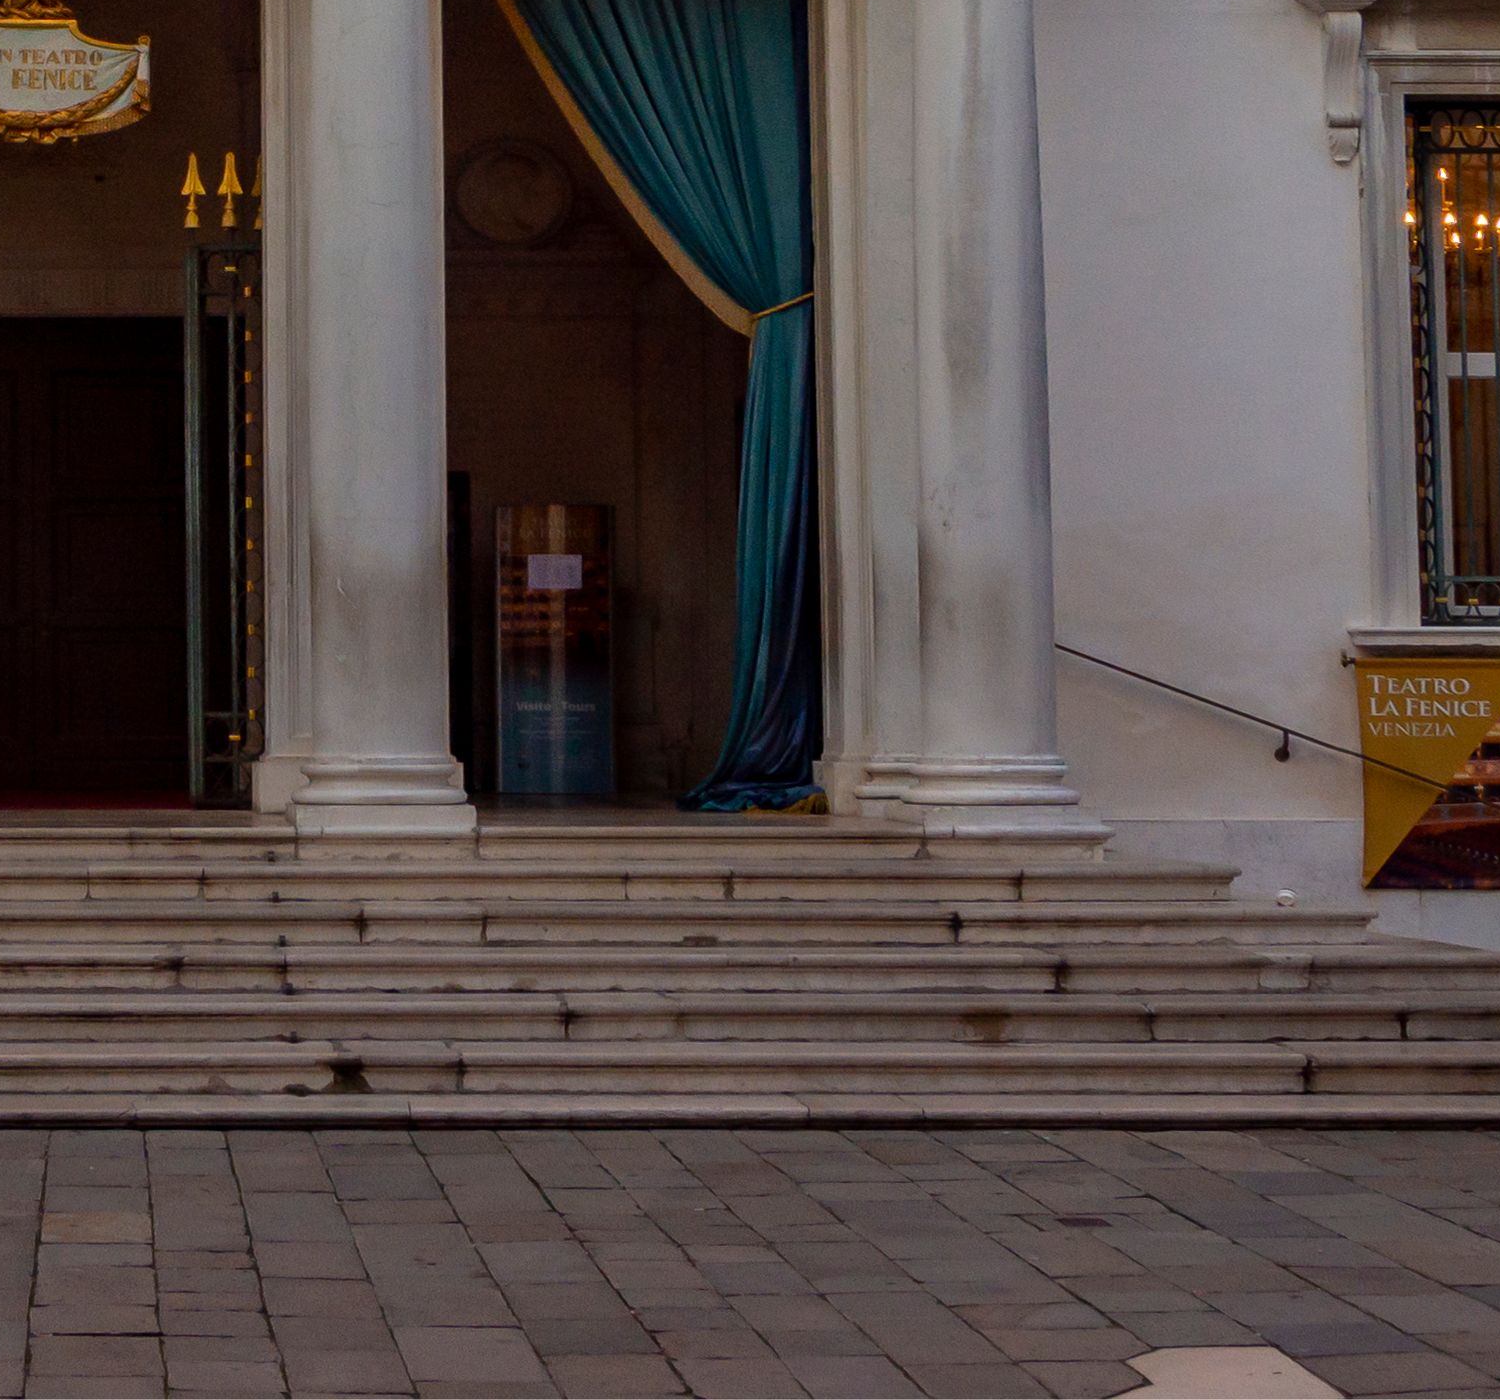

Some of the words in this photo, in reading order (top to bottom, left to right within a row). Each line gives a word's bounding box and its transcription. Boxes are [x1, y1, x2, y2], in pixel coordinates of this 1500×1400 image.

[17, 48, 104, 66] TEATRO
[11, 68, 98, 91] FENICE
[1366, 674, 1471, 696] TEATRO
[1368, 697, 1400, 717] LA
[1405, 697, 1492, 718] FENICE
[1369, 722, 1457, 737] VENEZIA
